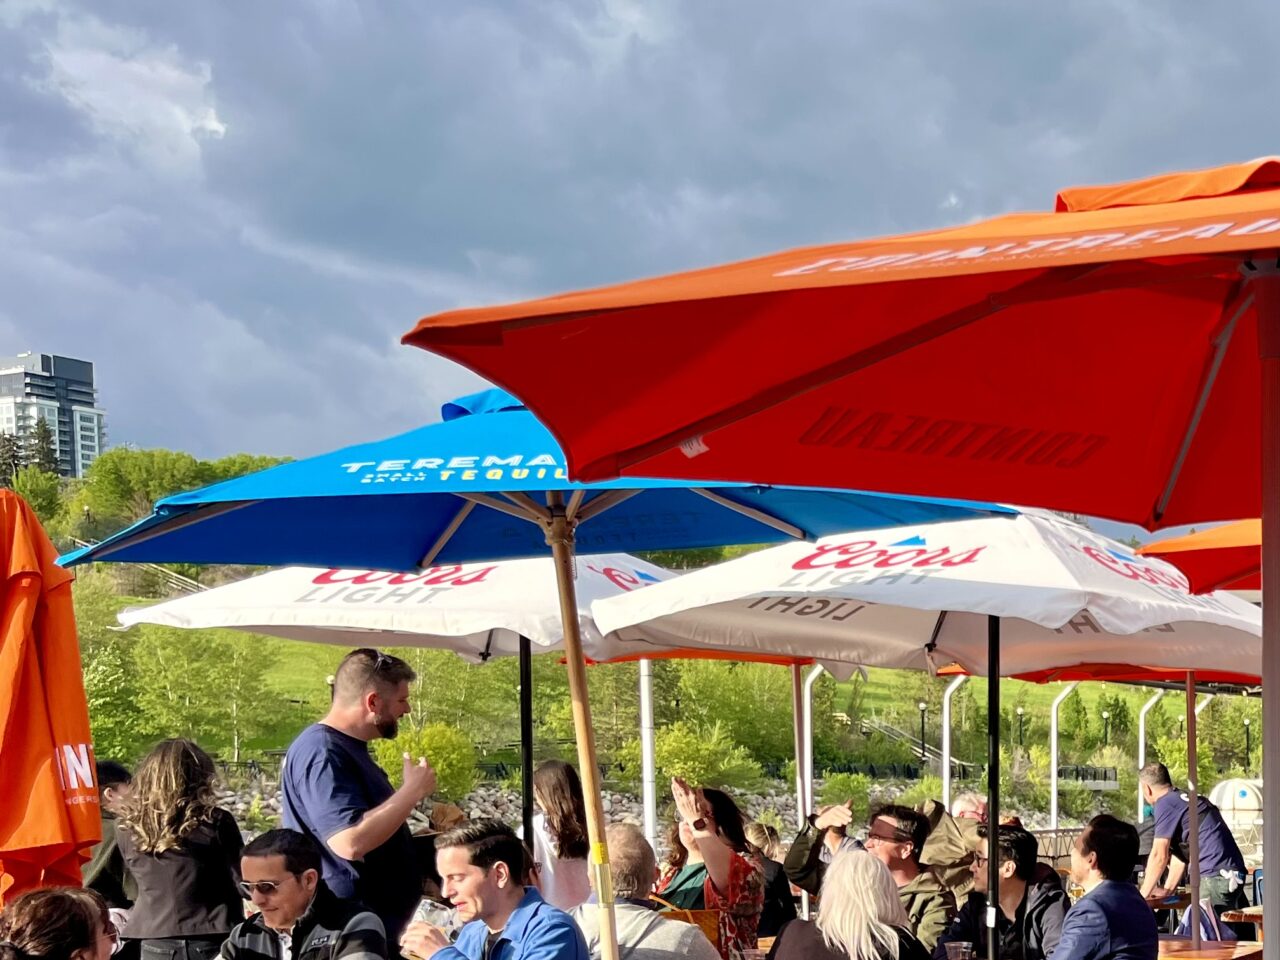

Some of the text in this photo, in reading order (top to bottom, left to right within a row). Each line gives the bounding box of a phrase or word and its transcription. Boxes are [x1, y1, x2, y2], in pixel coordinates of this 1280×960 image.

[340, 454, 566, 473] TEREMA
[440, 467, 568, 481] TEQUIL
[792, 540, 988, 570] Coors
[778, 568, 945, 588] LIGHT
[294, 586, 453, 604] LIGHT
